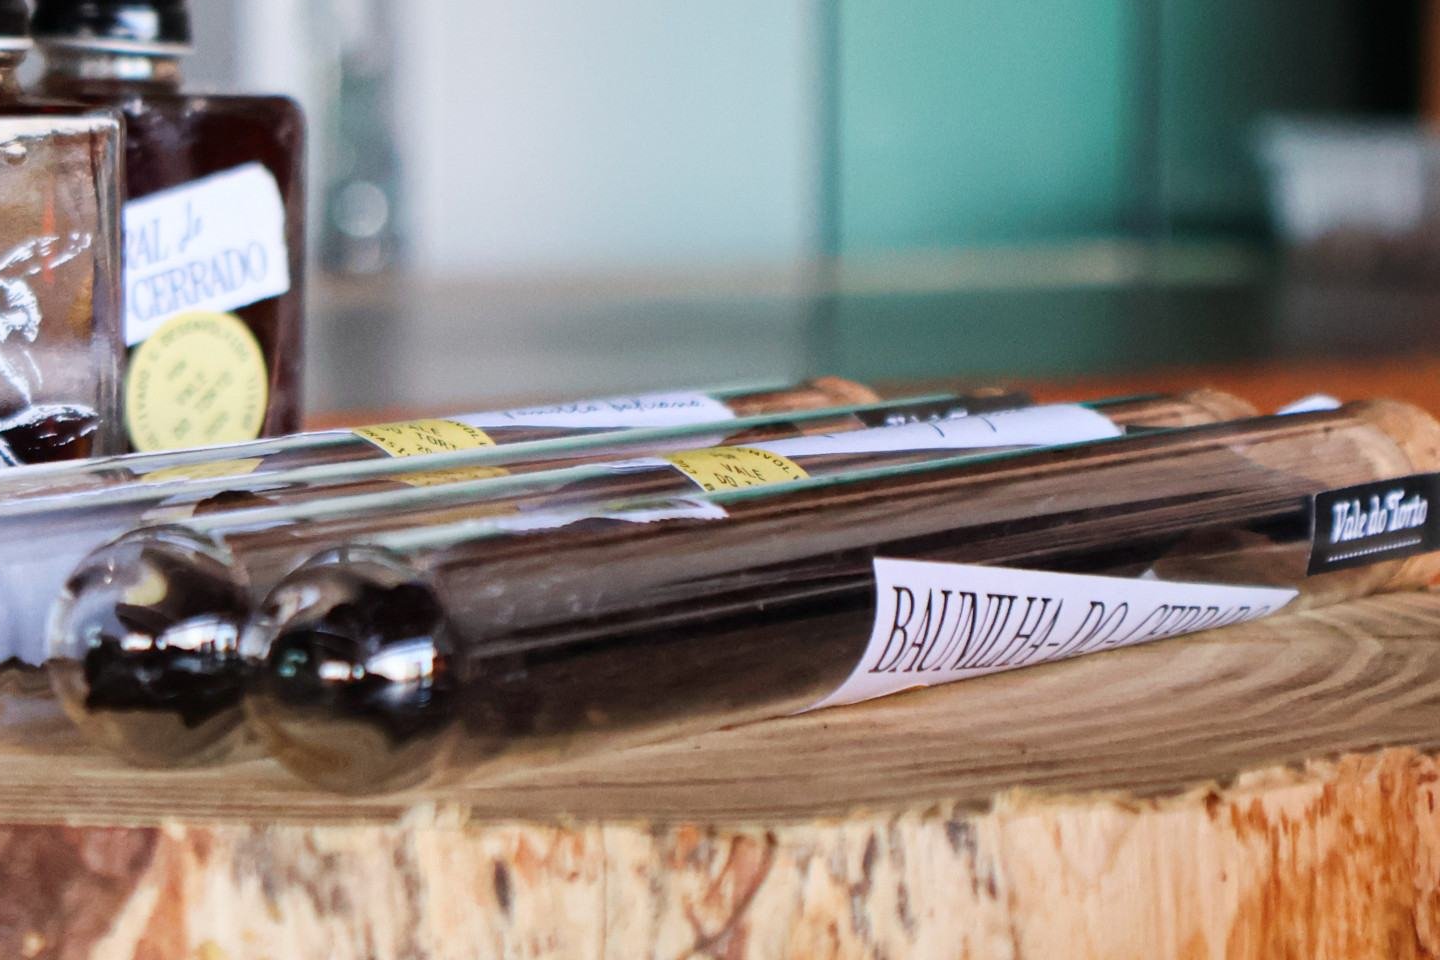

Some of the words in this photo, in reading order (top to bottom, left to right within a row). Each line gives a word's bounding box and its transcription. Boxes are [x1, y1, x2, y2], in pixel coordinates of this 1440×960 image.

[1329, 499, 1367, 544] Vale
[1366, 494, 1388, 539] do
[1384, 488, 1429, 533] Torto
